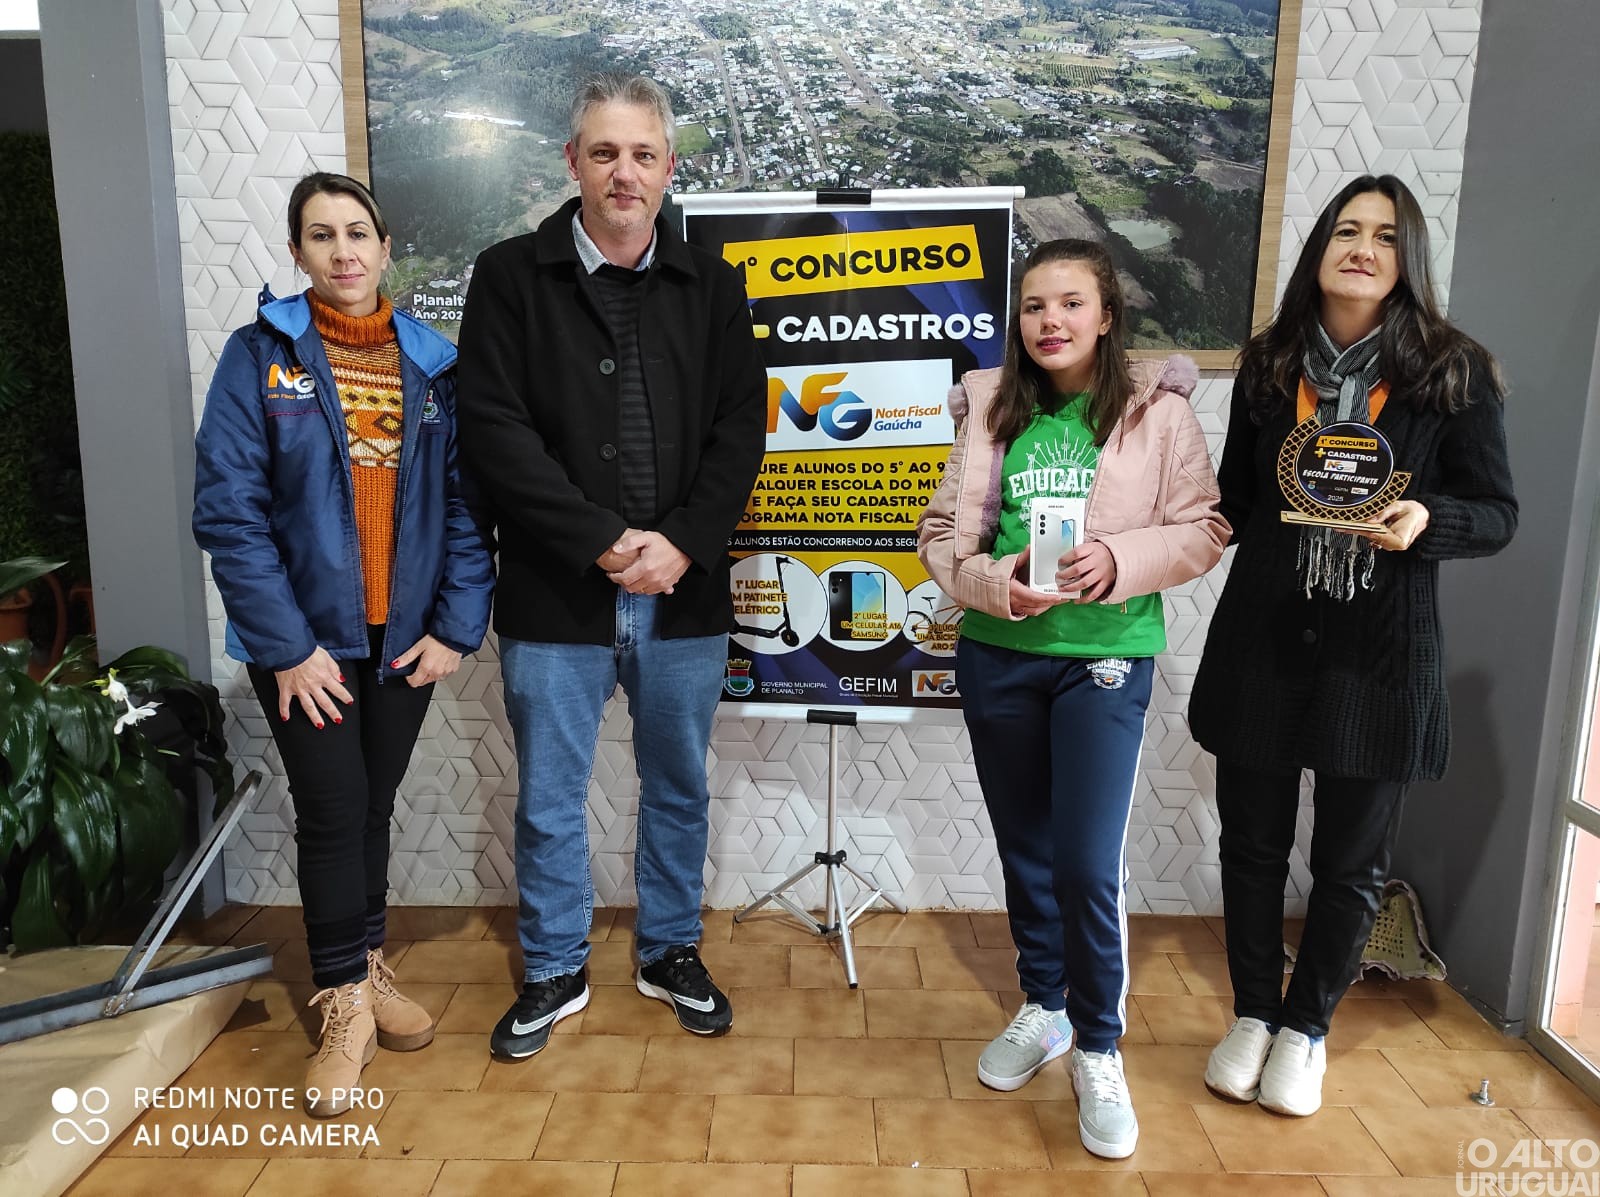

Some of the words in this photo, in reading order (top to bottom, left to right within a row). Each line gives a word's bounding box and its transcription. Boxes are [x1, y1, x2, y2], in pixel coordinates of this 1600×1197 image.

[770, 242, 971, 282] CONCURSO
[413, 293, 466, 307] Planalt
[414, 310, 438, 320] Ano
[776, 313, 995, 343] CADASTROS
[875, 408, 905, 419] Nota
[907, 404, 942, 417] Fiscal
[874, 418, 922, 431] Gaúcha
[1329, 439, 1375, 448] CONCURSO
[1327, 450, 1378, 462] CADASTROS
[793, 463, 856, 474] ALUNOS
[862, 462, 884, 474] DO
[908, 462, 931, 473] AO
[1302, 469, 1330, 479] ESCOLA
[1330, 472, 1379, 485] PARTICIPANTE
[821, 479, 884, 490] ESCOLA
[889, 479, 912, 490] DO
[752, 496, 761, 506] E
[767, 496, 806, 510] FAÇA
[811, 496, 841, 507] SEU
[846, 495, 930, 507] CADASTRO
[813, 512, 854, 523] NOTA
[860, 512, 914, 523] FISCAL
[734, 537, 771, 546] ALUNOS
[772, 535, 801, 546] ESTÃO
[803, 537, 873, 546] CONCORRENDO
[874, 537, 894, 547] AOS
[745, 580, 779, 590] LUGAR
[744, 592, 788, 602] PATINETE
[734, 603, 780, 614] ELÉTRICO
[841, 621, 853, 629] UM
[855, 621, 887, 629] CELULAR
[888, 622, 902, 630] A16
[917, 633, 935, 641] UMA
[838, 676, 897, 693] GEFIM
[917, 672, 956, 695] NFG
